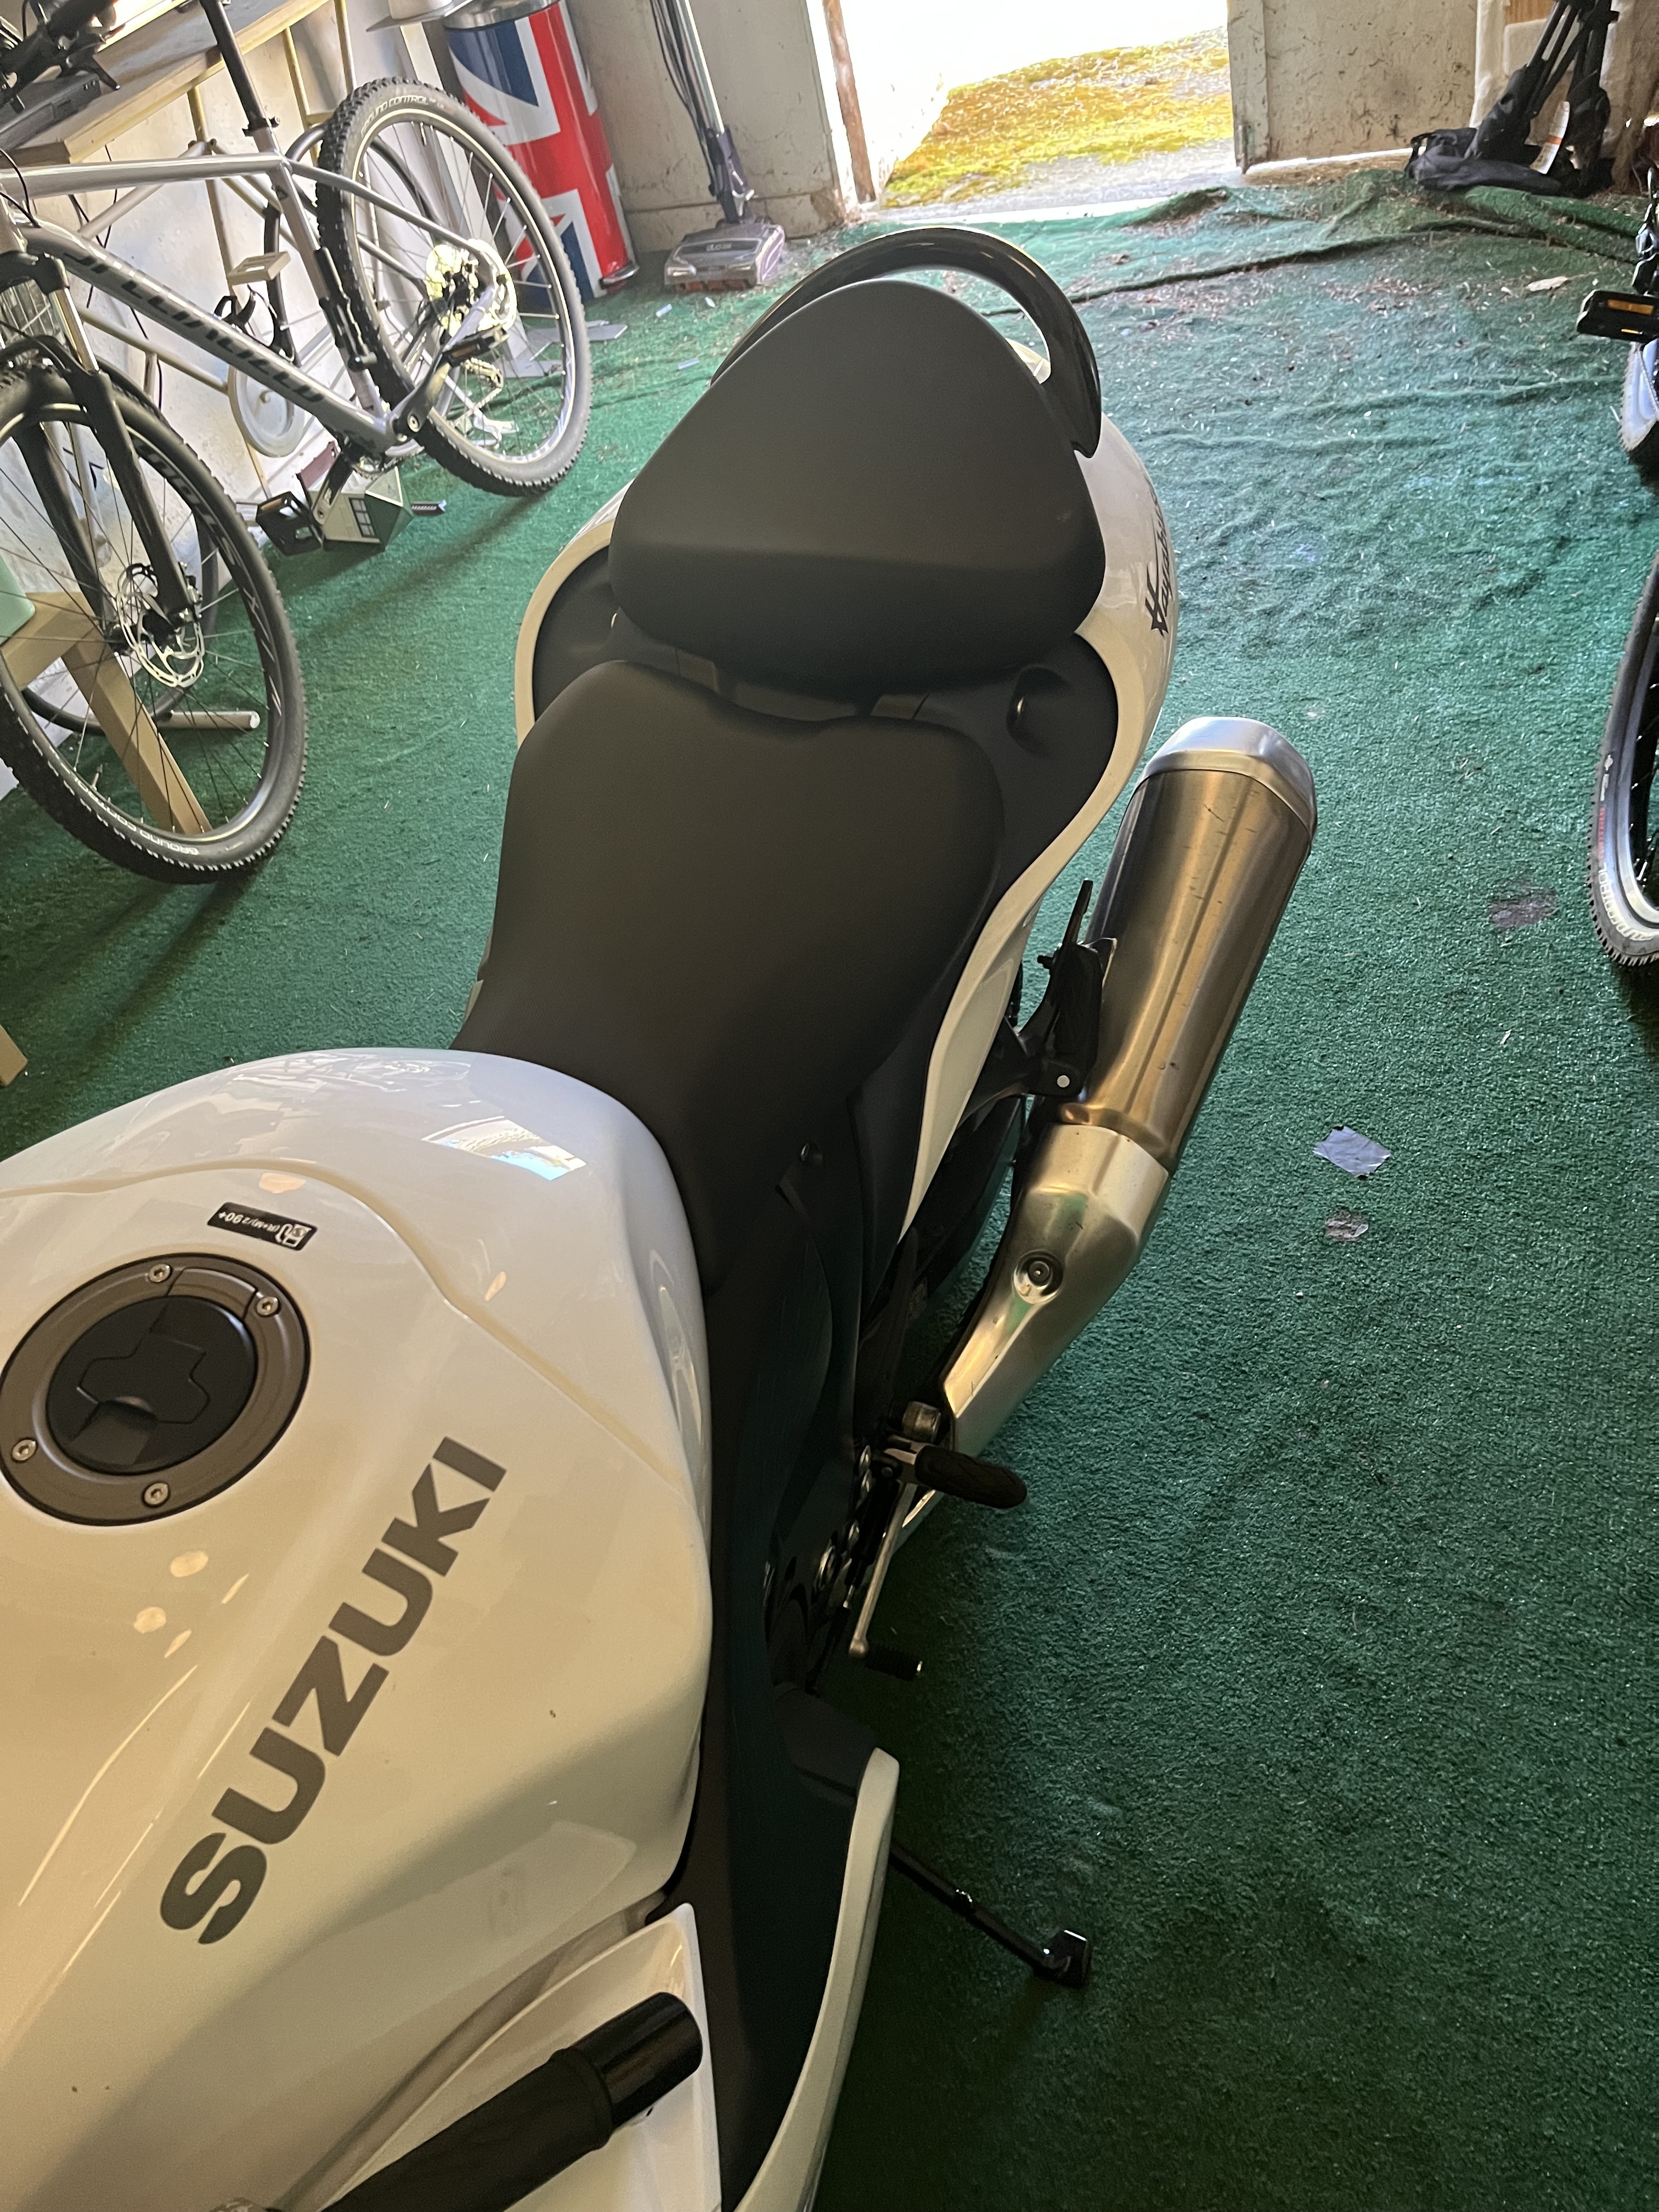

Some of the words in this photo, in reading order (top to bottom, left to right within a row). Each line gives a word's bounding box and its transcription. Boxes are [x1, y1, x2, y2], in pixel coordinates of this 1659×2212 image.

[388, 95, 428, 108] CONTROL
[139, 829, 199, 856] GROUND
[218, 1211, 244, 1224] 90+
[159, 1436, 507, 1945] SUZUKI
